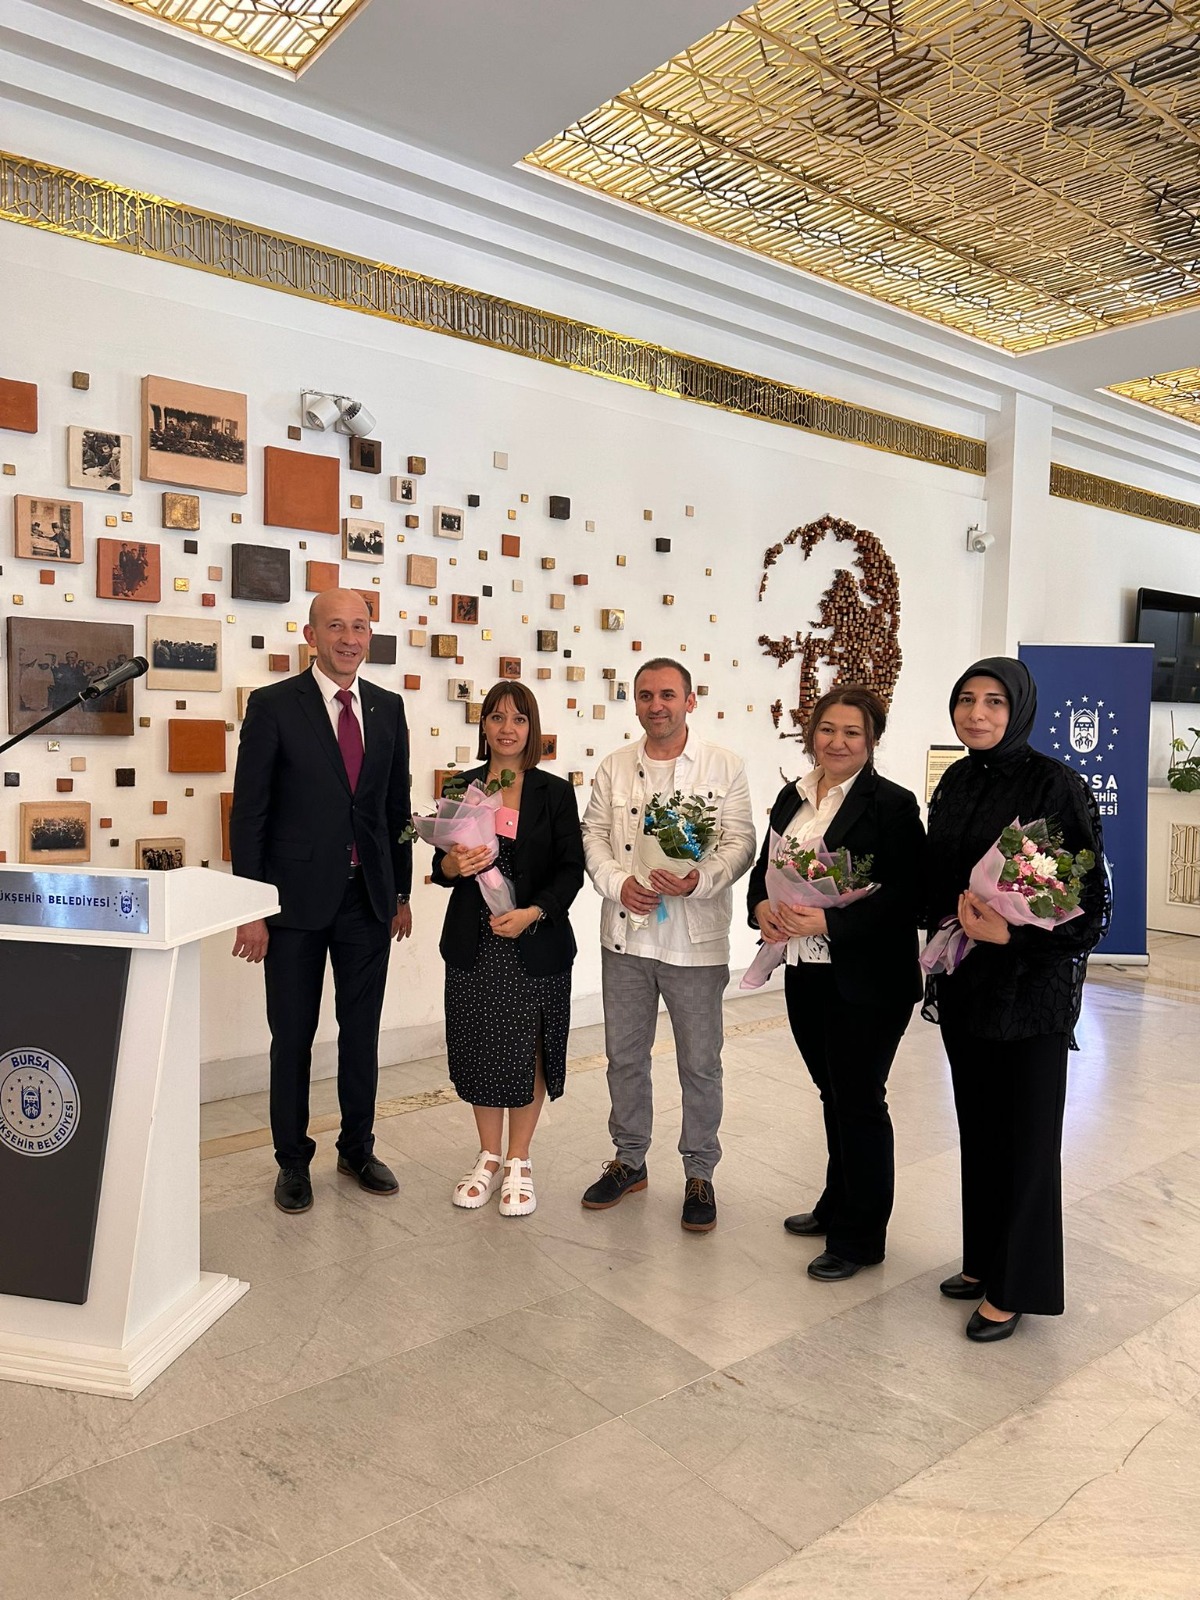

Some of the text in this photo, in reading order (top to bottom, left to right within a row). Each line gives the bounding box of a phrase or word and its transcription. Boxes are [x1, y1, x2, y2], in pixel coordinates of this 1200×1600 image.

[48, 894, 110, 908] BELEDİYESİ
[11, 1054, 50, 1071] BURSA
[37, 1101, 74, 1150] BELEDİYESİ
